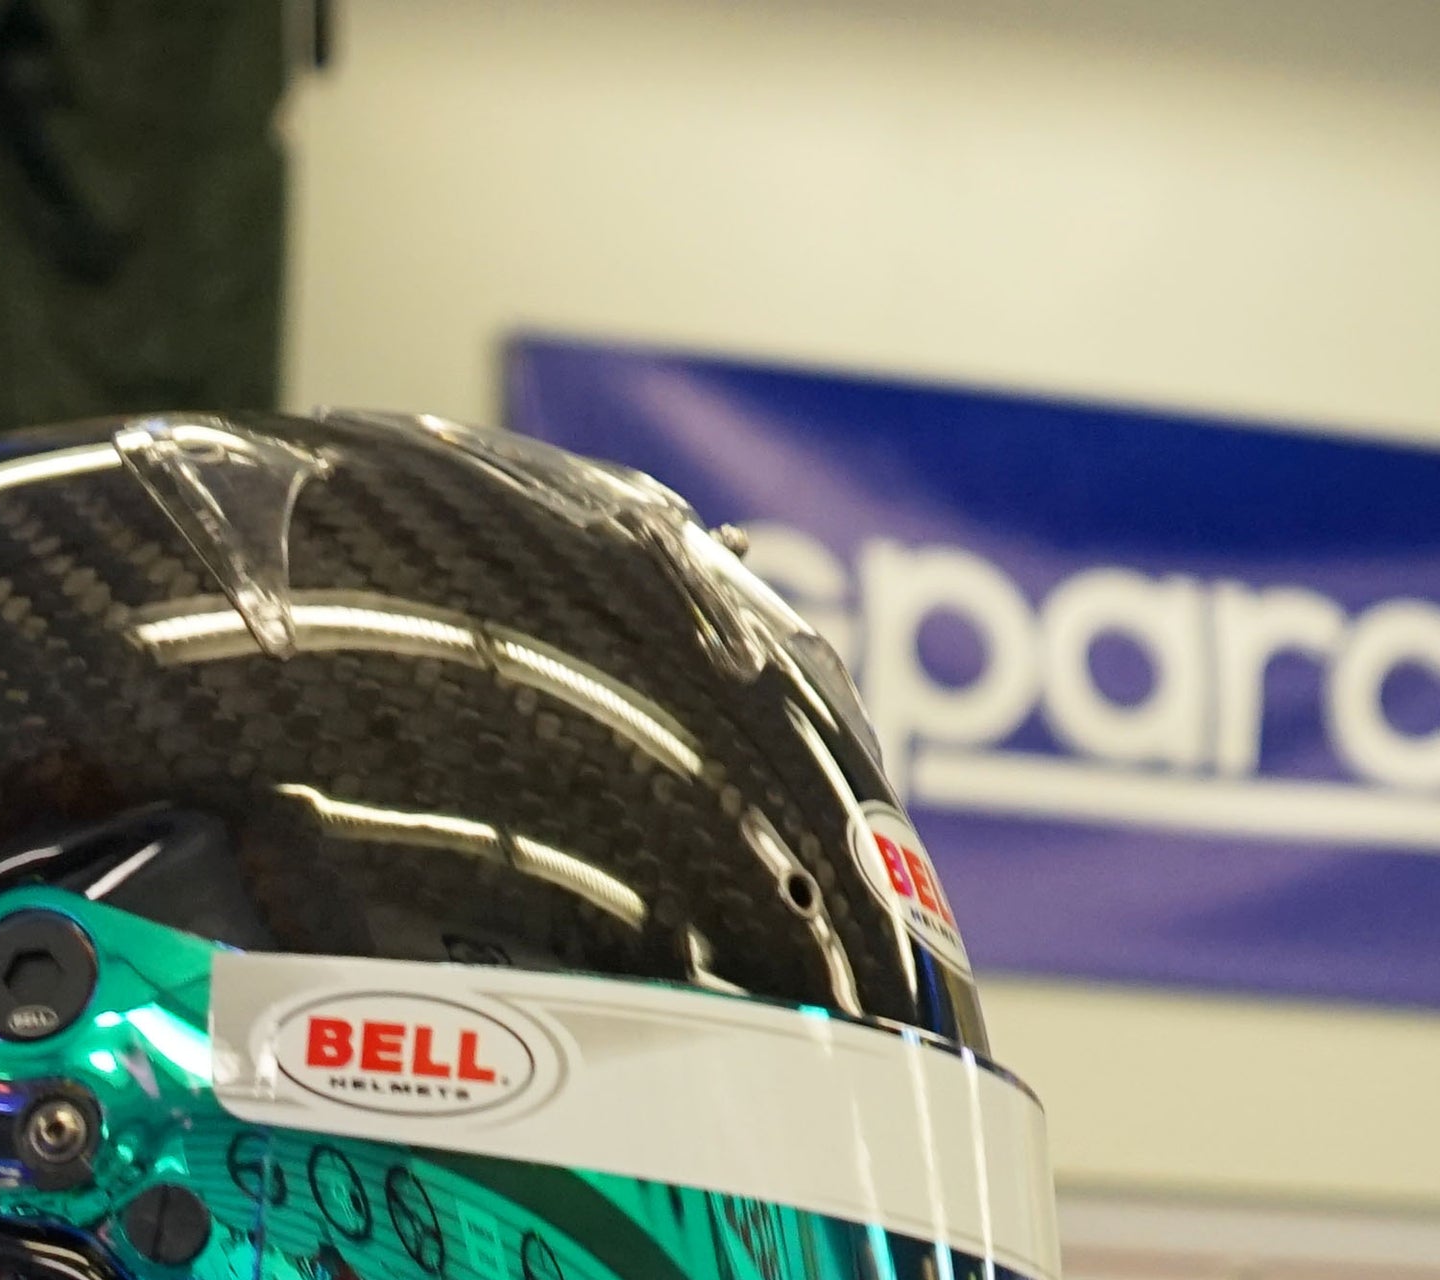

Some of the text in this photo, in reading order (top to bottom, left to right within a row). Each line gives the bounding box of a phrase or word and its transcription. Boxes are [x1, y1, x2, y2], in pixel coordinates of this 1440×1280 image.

[874, 833, 954, 927] BEL
[306, 1016, 495, 1083] BELL
[331, 1077, 471, 1101] HELMETS
